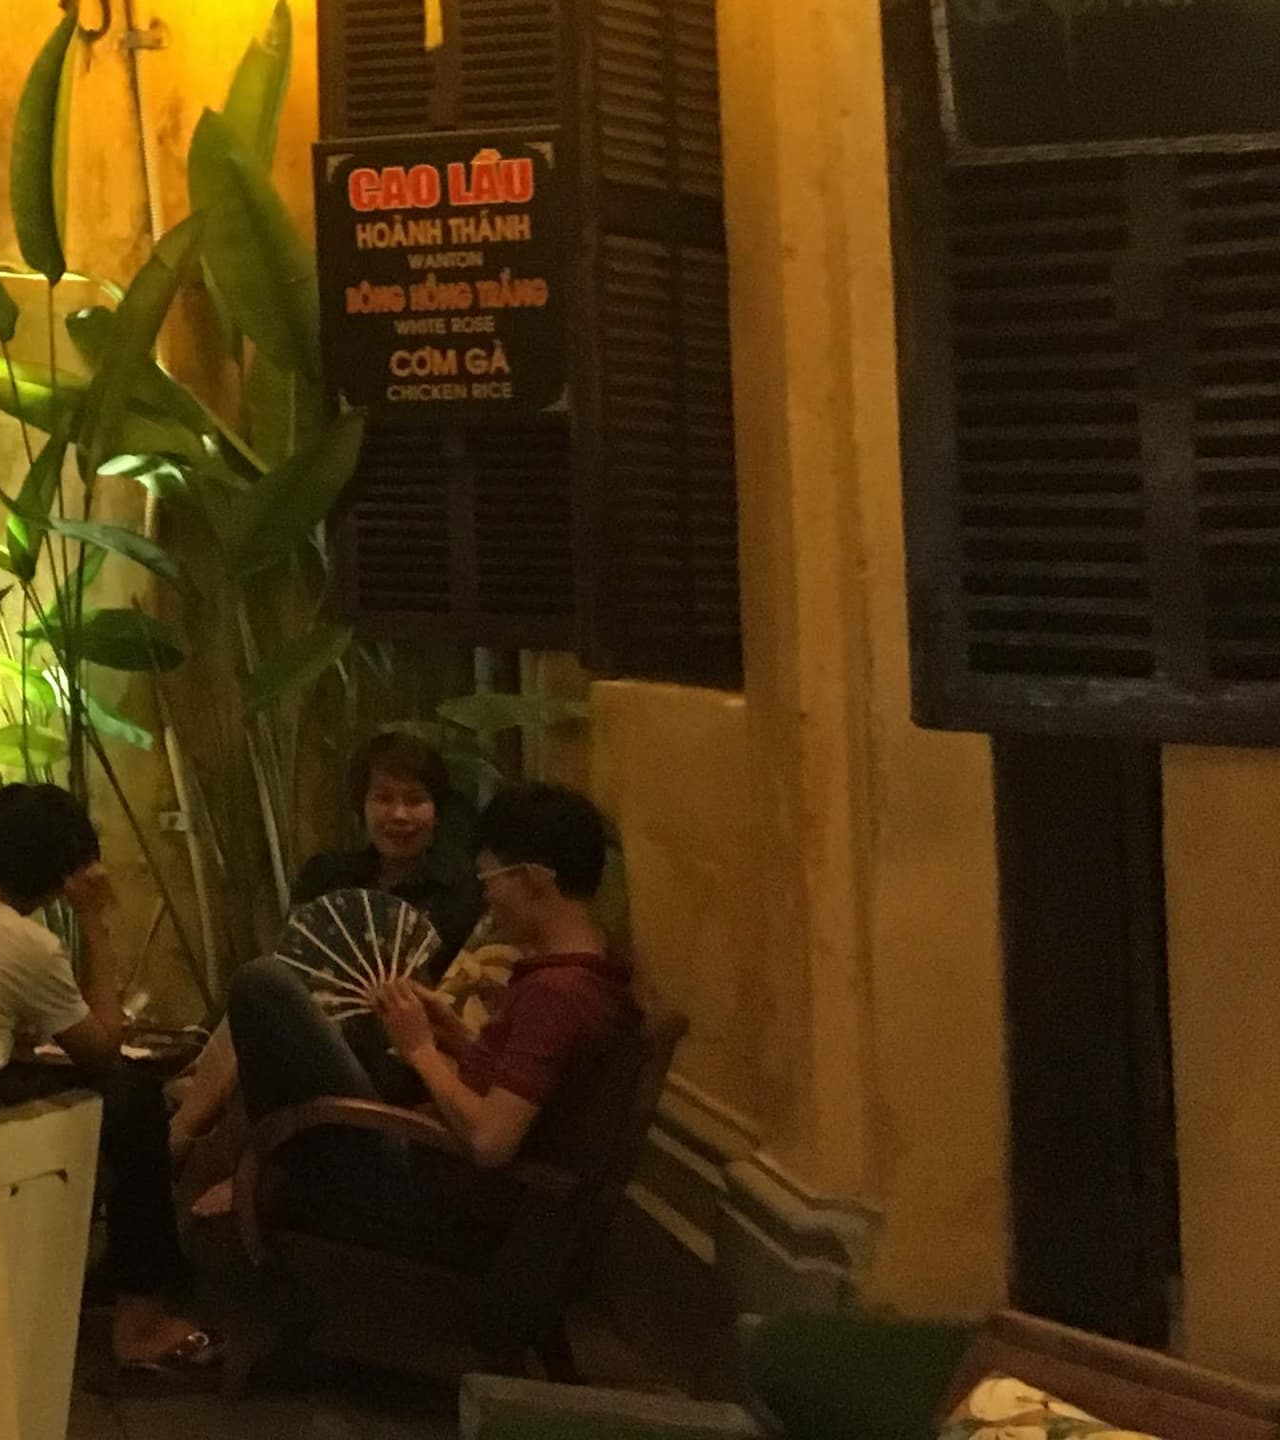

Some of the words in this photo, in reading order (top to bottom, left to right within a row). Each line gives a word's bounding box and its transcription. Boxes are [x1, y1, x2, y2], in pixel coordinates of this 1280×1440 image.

[348, 164, 441, 211] CAO
[407, 251, 484, 270] WANTON
[393, 318, 447, 336] WHITE
[450, 315, 496, 334] ROSE
[464, 338, 511, 376] GÀ
[386, 383, 469, 402] CHICKEN
[471, 381, 513, 400] RICE
